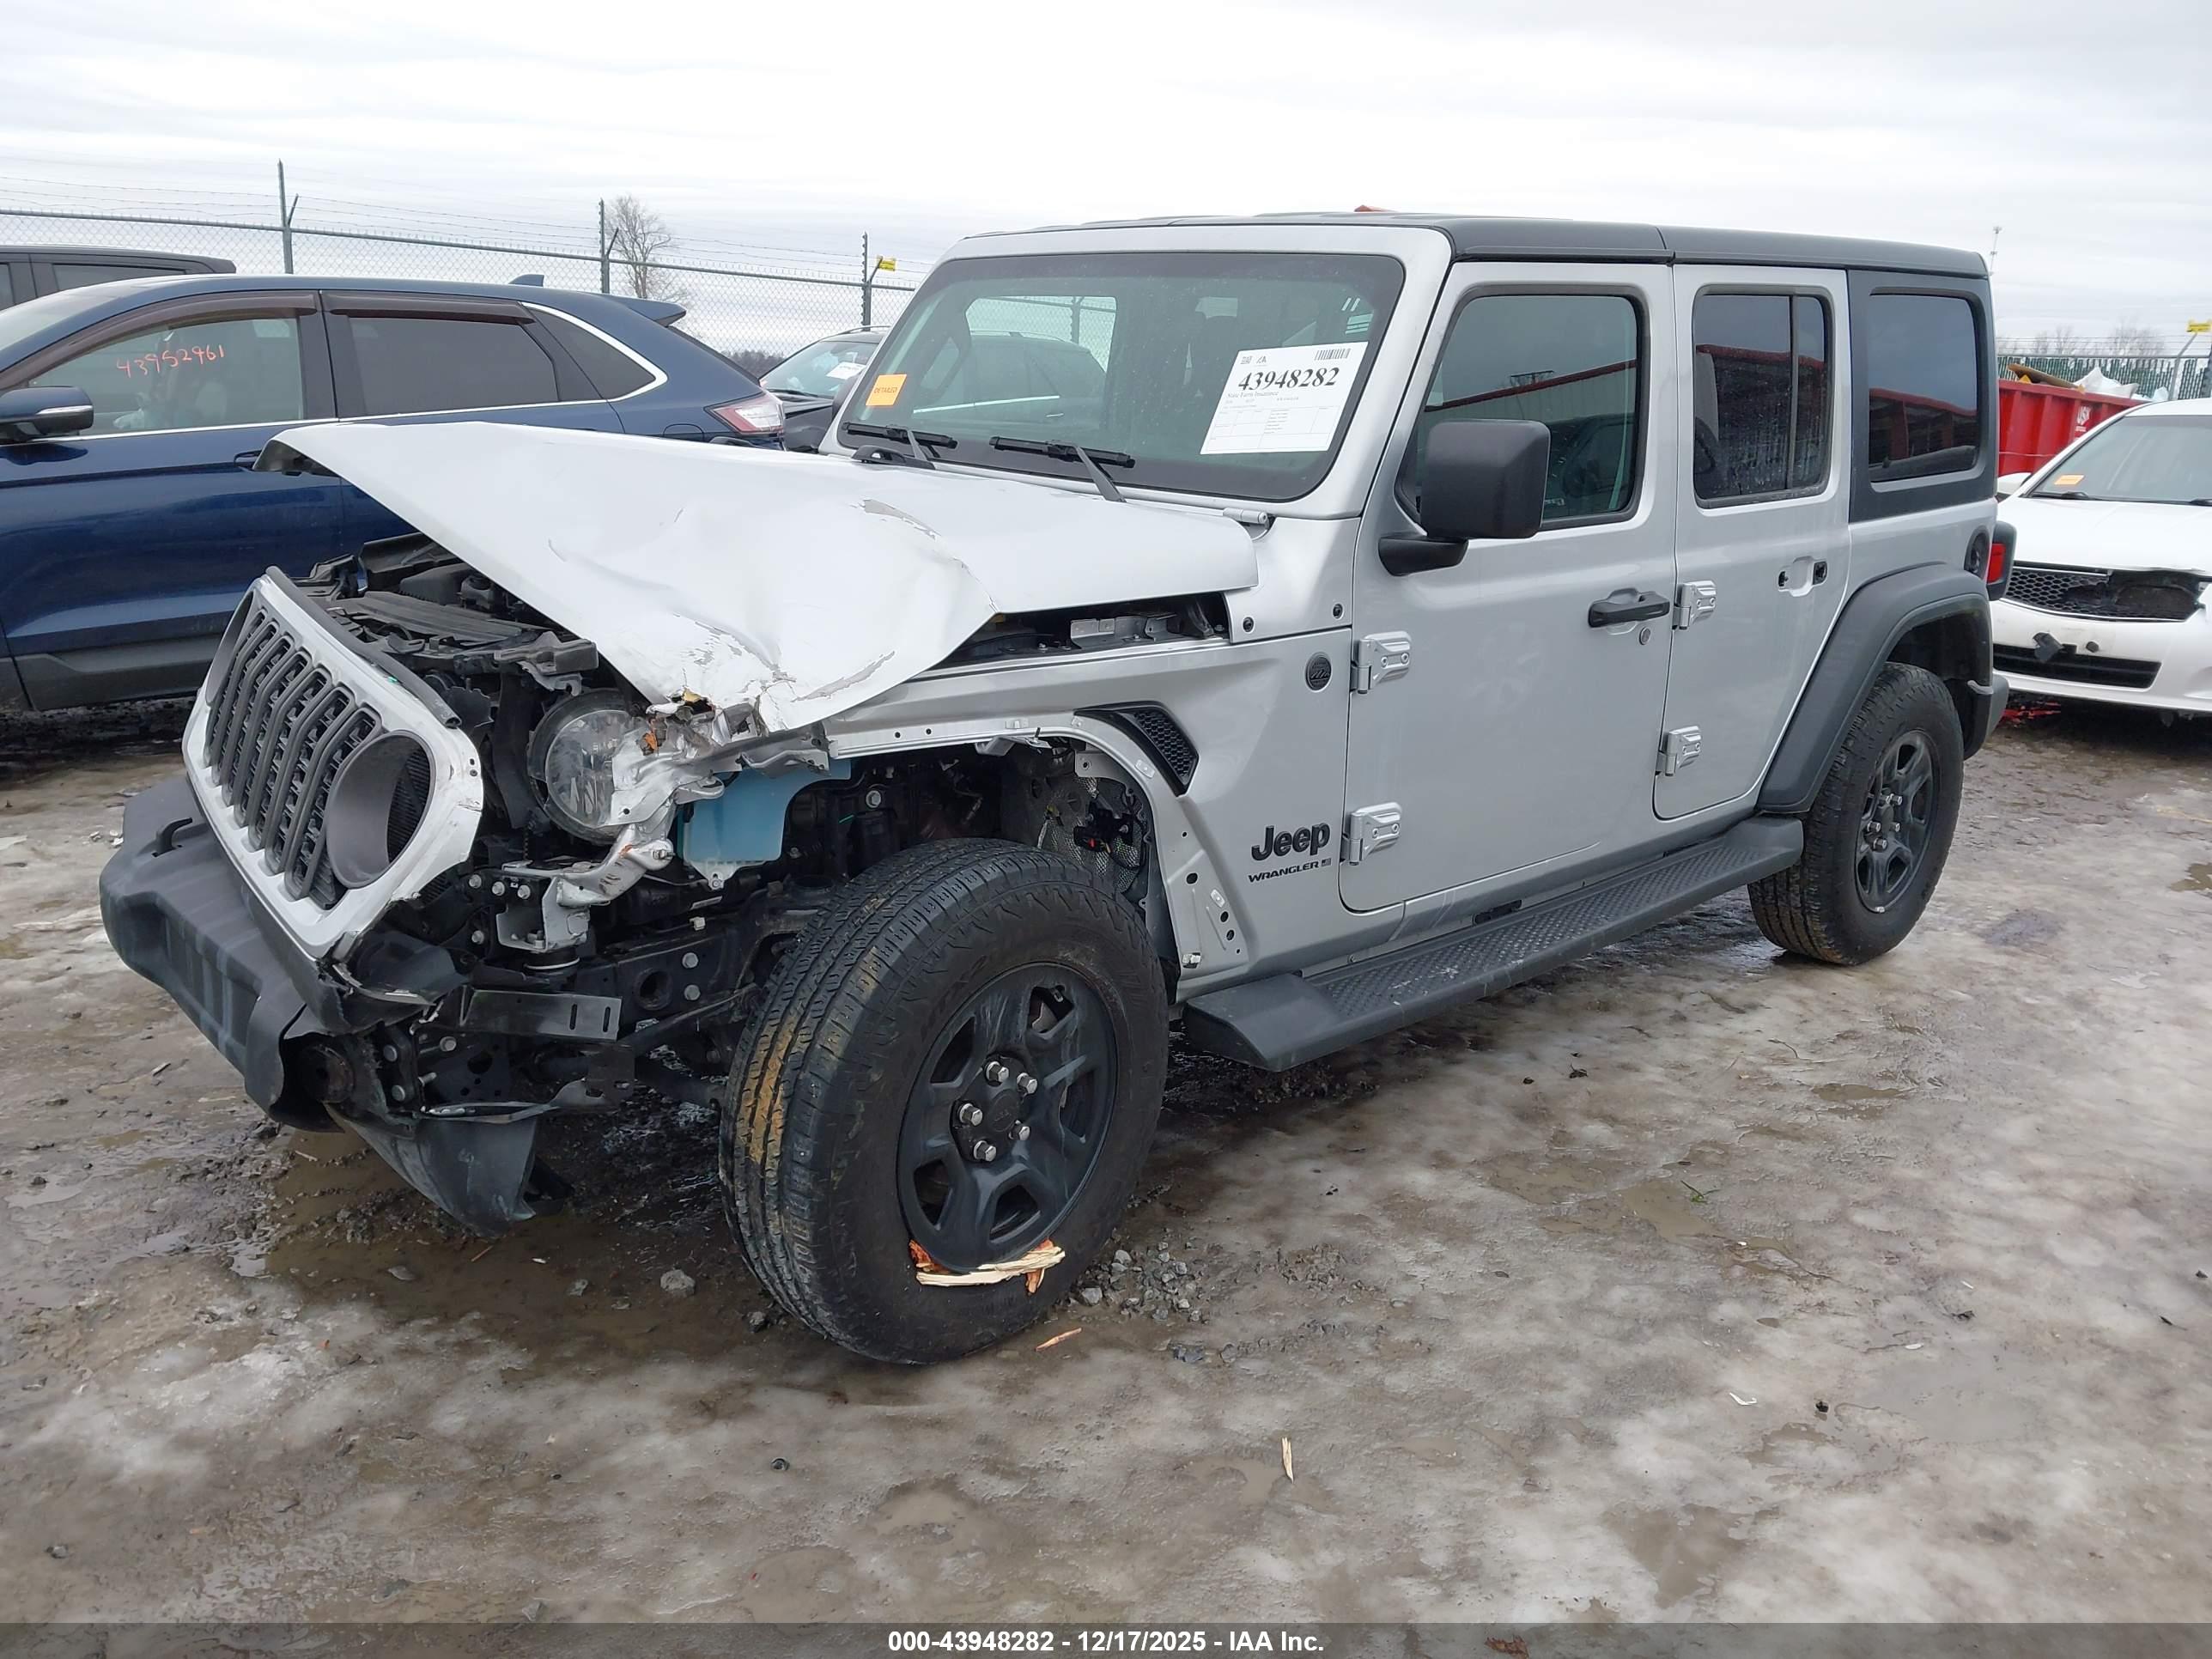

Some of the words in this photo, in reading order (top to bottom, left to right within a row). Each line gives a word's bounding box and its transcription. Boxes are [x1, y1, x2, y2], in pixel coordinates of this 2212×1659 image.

[1238, 368, 1340, 391] 43948282
[1251, 823, 1330, 861] Jeep
[1248, 860, 1320, 884] WRANGLER
